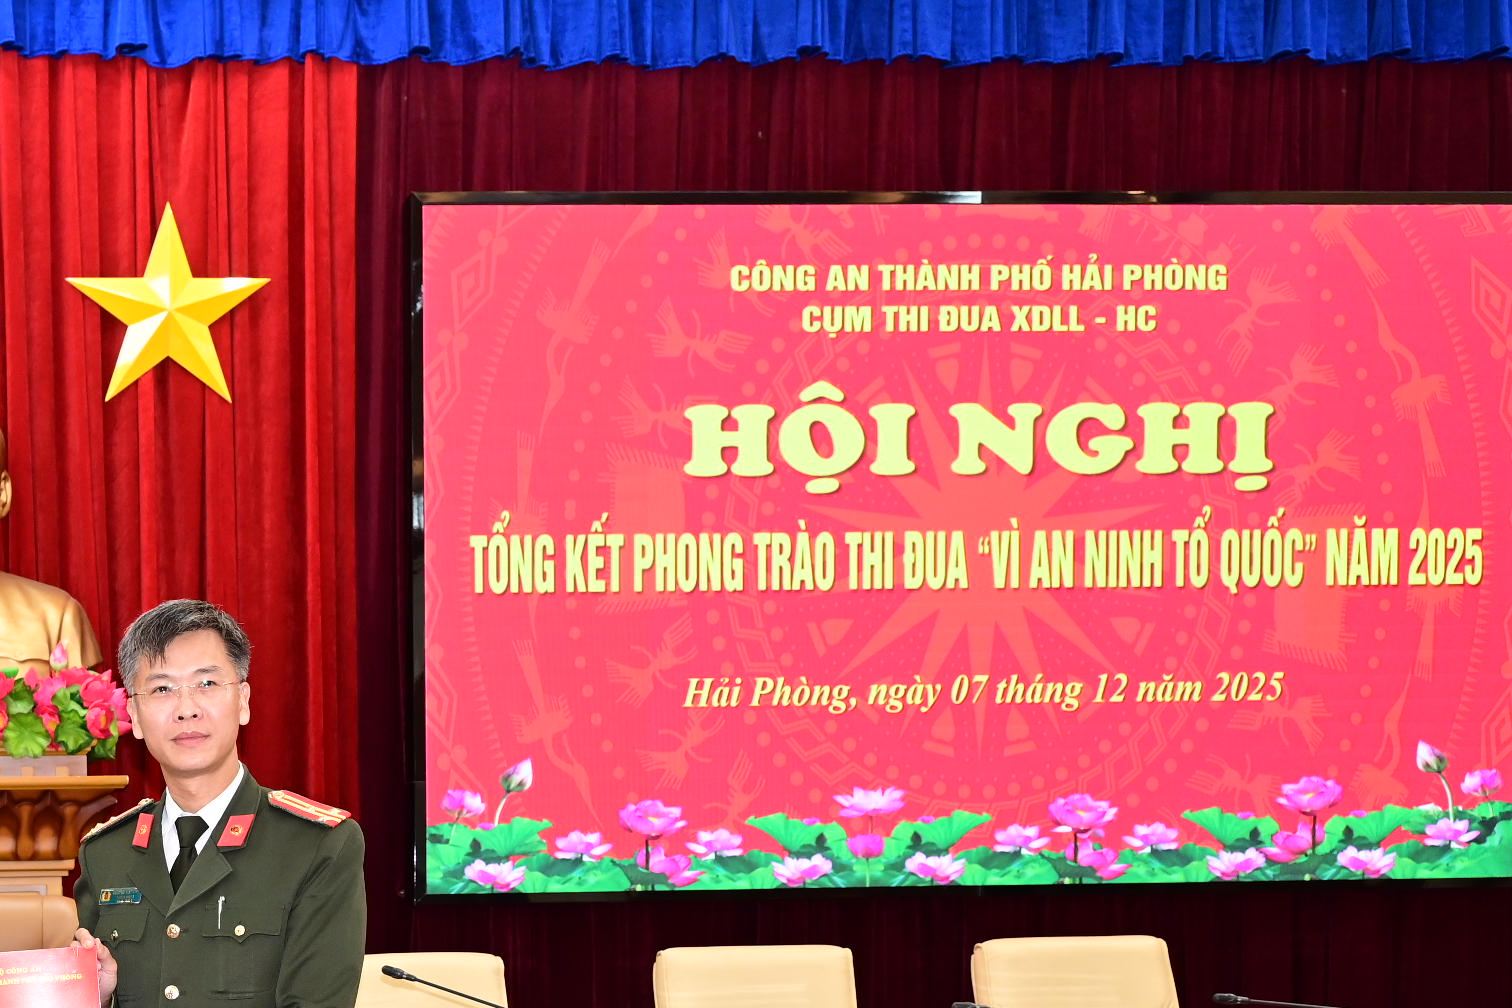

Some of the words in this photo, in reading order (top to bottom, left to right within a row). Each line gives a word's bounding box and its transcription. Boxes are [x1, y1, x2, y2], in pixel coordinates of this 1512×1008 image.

[730, 259, 815, 291] CÔNG
[826, 265, 869, 291] AN
[878, 259, 980, 291] THÀNH
[990, 255, 1053, 290] PHỐ
[1062, 254, 1113, 290] HẢI
[1123, 258, 1228, 291] PHÒNG
[802, 305, 872, 338] CỤM
[881, 305, 929, 332] THI
[938, 305, 1001, 331] ĐUA
[1011, 305, 1085, 331] XDLL
[1116, 305, 1157, 331] HC
[683, 380, 916, 494] HỘI
[949, 402, 1275, 492] NGHỊ
[470, 510, 555, 594] TỔNG
[566, 512, 624, 593] KẾT
[633, 532, 744, 592] PHONG
[753, 519, 835, 592] TRÀO
[845, 531, 893, 590] THI
[903, 530, 968, 590] ĐUA
[978, 517, 1020, 589] “VÌ
[1029, 530, 1075, 589] AN
[1084, 530, 1163, 588] NINH
[1172, 505, 1212, 588] TỔ
[1326, 515, 1399, 586] NĂM
[1408, 528, 1483, 586] 2025
[683, 676, 742, 708] Hải
[750, 675, 858, 715] Phòng,
[868, 675, 942, 713] ngày
[951, 675, 988, 703] 07
[994, 674, 1083, 711] tháng
[1093, 673, 1128, 702] 12
[1136, 674, 1203, 702] năm
[1211, 672, 1285, 702] 2025
[6, 967, 28, 975] CÔNG
